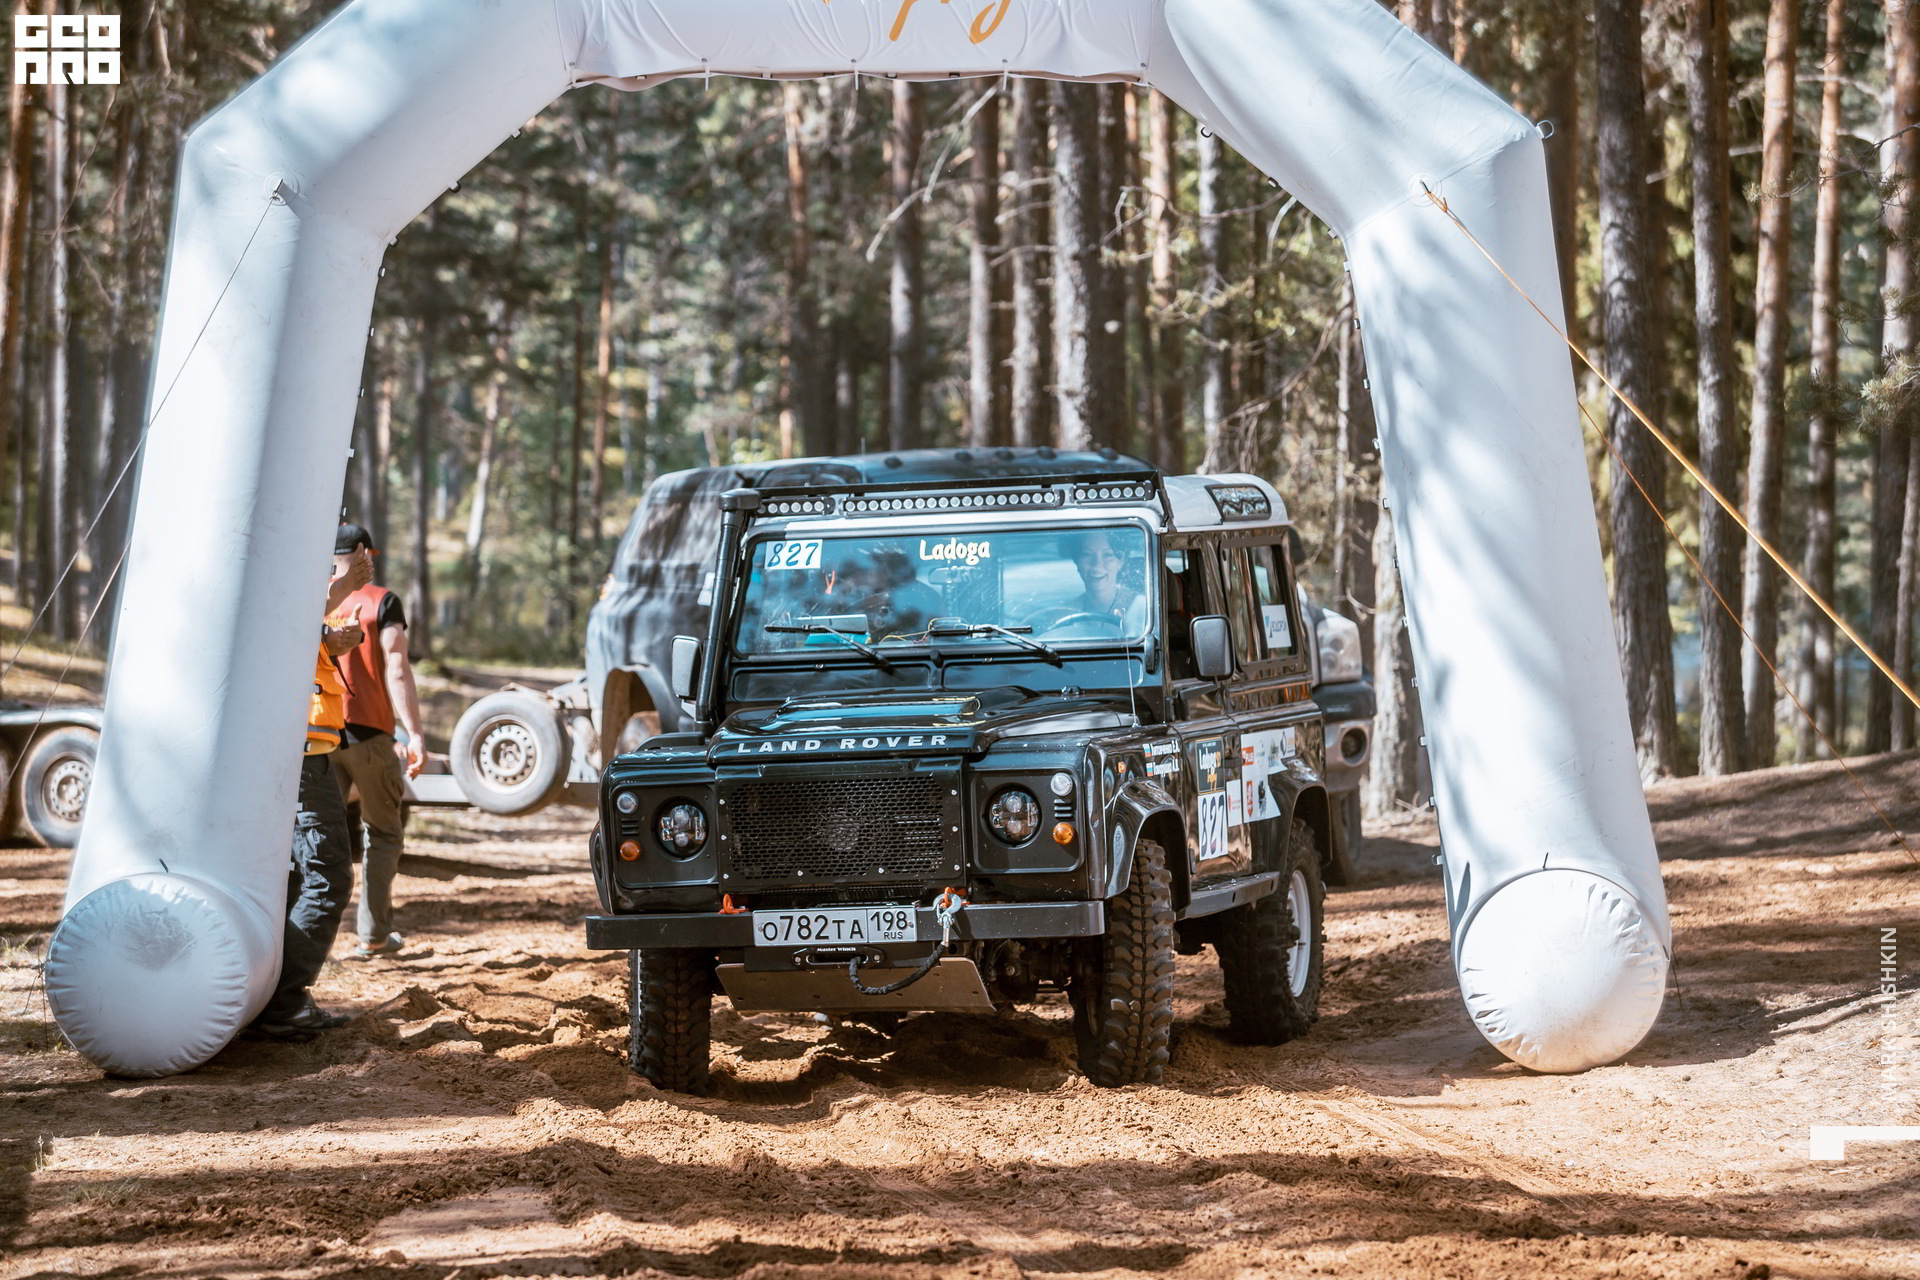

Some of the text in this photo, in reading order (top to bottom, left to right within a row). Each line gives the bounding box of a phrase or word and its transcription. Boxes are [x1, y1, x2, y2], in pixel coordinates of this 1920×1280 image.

[767, 543, 819, 567] 827
[919, 538, 990, 565] Ladoga
[738, 734, 947, 753] LAND ROVER
[1201, 795, 1225, 857] 827
[870, 911, 908, 932] 198
[883, 931, 904, 940] RUS
